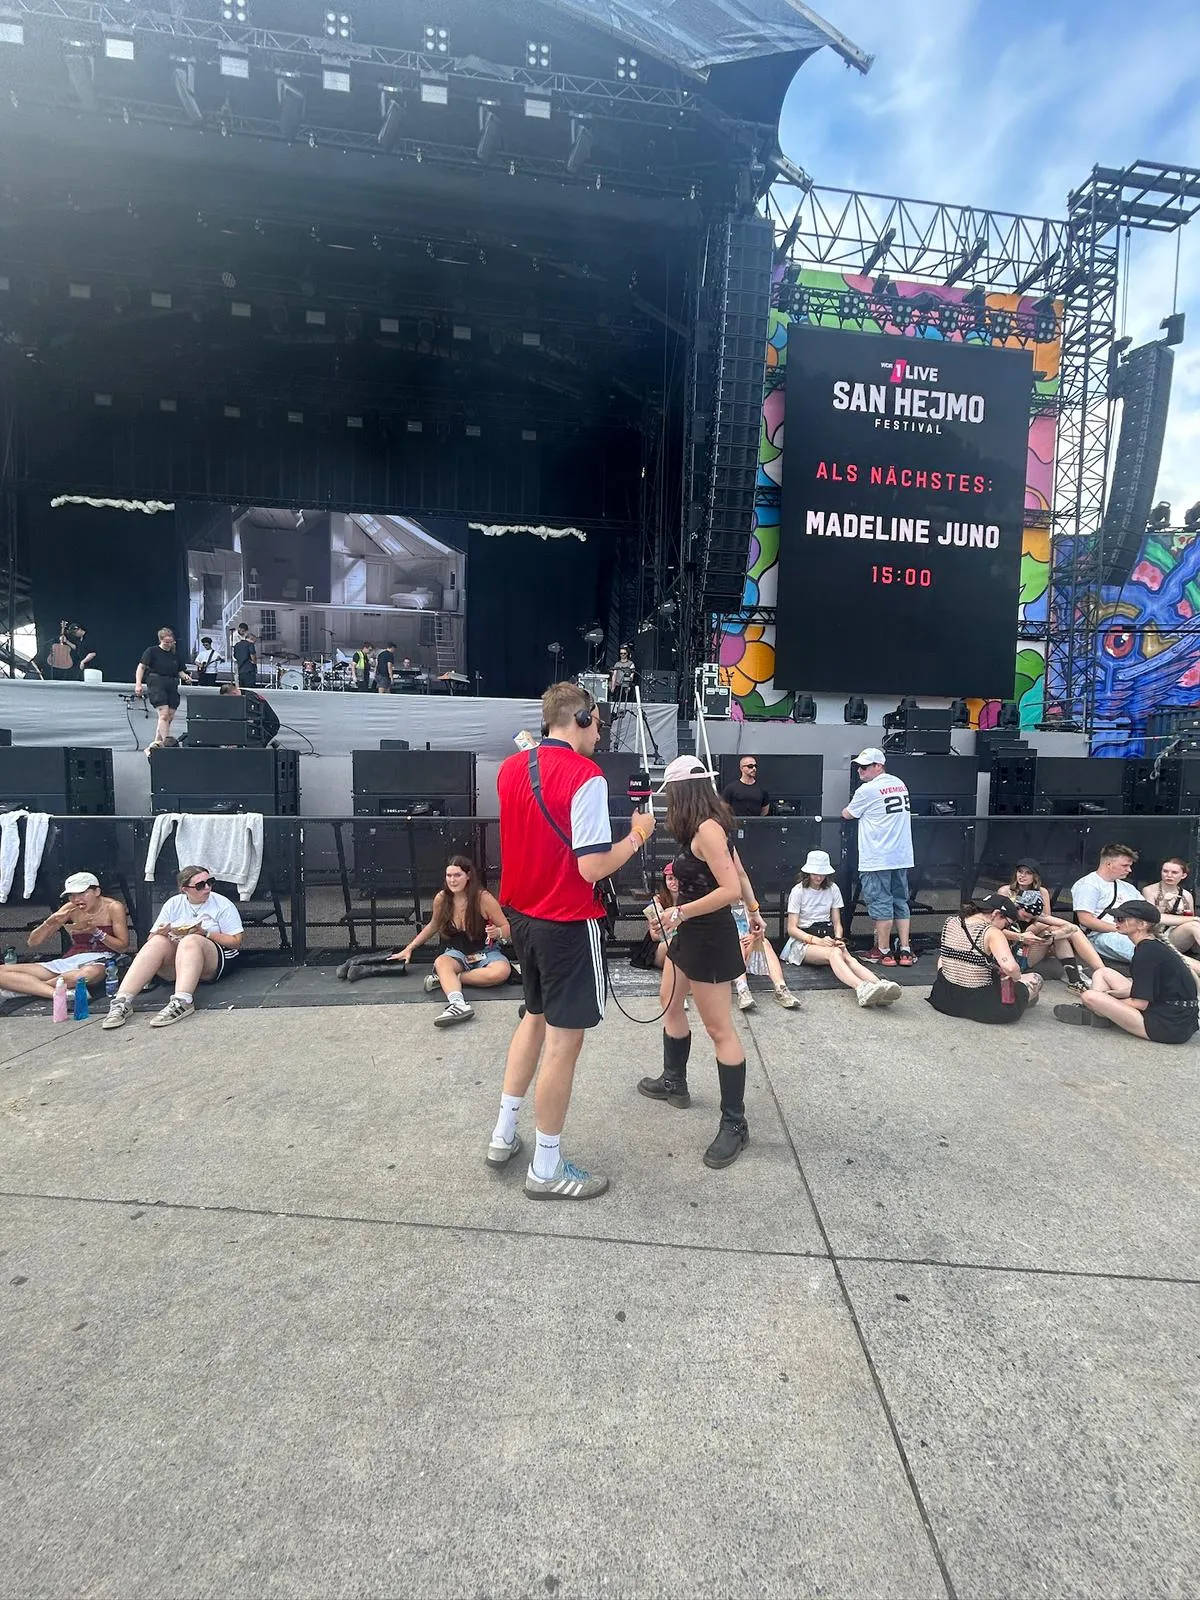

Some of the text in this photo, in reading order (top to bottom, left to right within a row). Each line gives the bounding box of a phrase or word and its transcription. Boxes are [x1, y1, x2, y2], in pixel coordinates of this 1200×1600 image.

[832, 381, 985, 424] SAN HEJMO
[875, 418, 942, 435] FESTIVAL
[816, 462, 993, 494] ALS NÄCHSTES:
[806, 510, 1000, 549] MADELINE JUNO
[872, 566, 933, 587] 15:00
